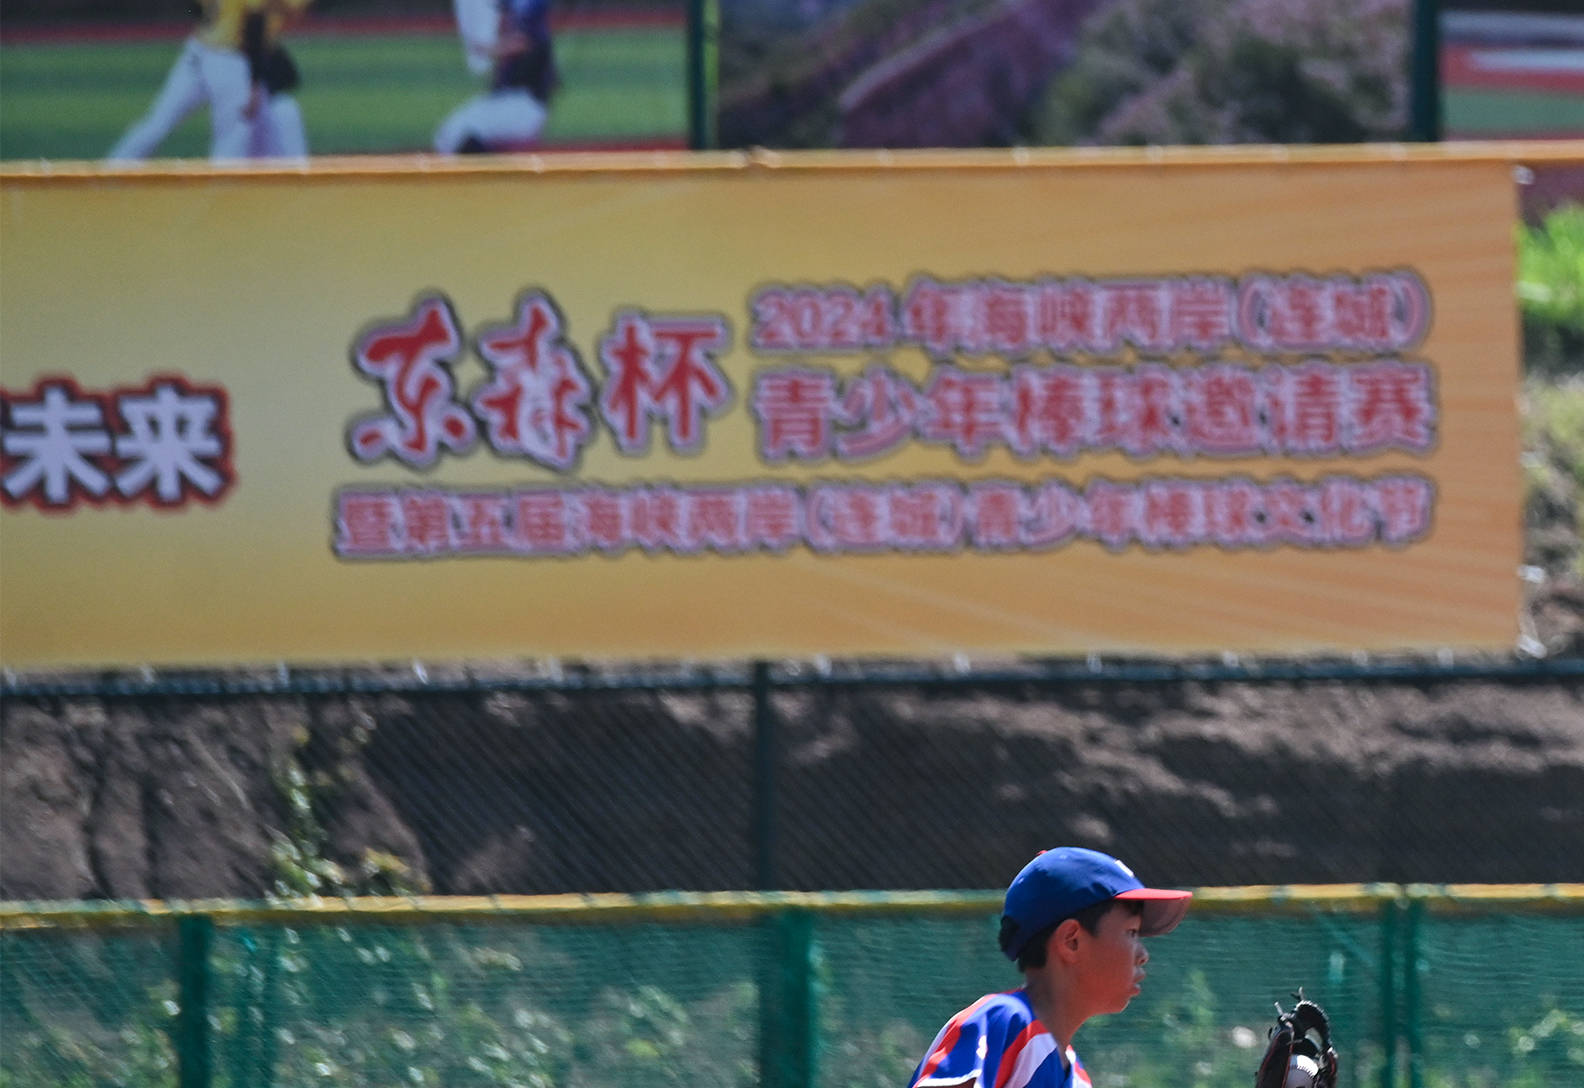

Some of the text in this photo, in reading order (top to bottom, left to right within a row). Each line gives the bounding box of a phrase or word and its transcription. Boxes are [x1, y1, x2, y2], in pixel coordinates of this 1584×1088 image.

[3, 384, 226, 502] 未来
[752, 362, 1437, 460] 青少年棒球邀请赛
